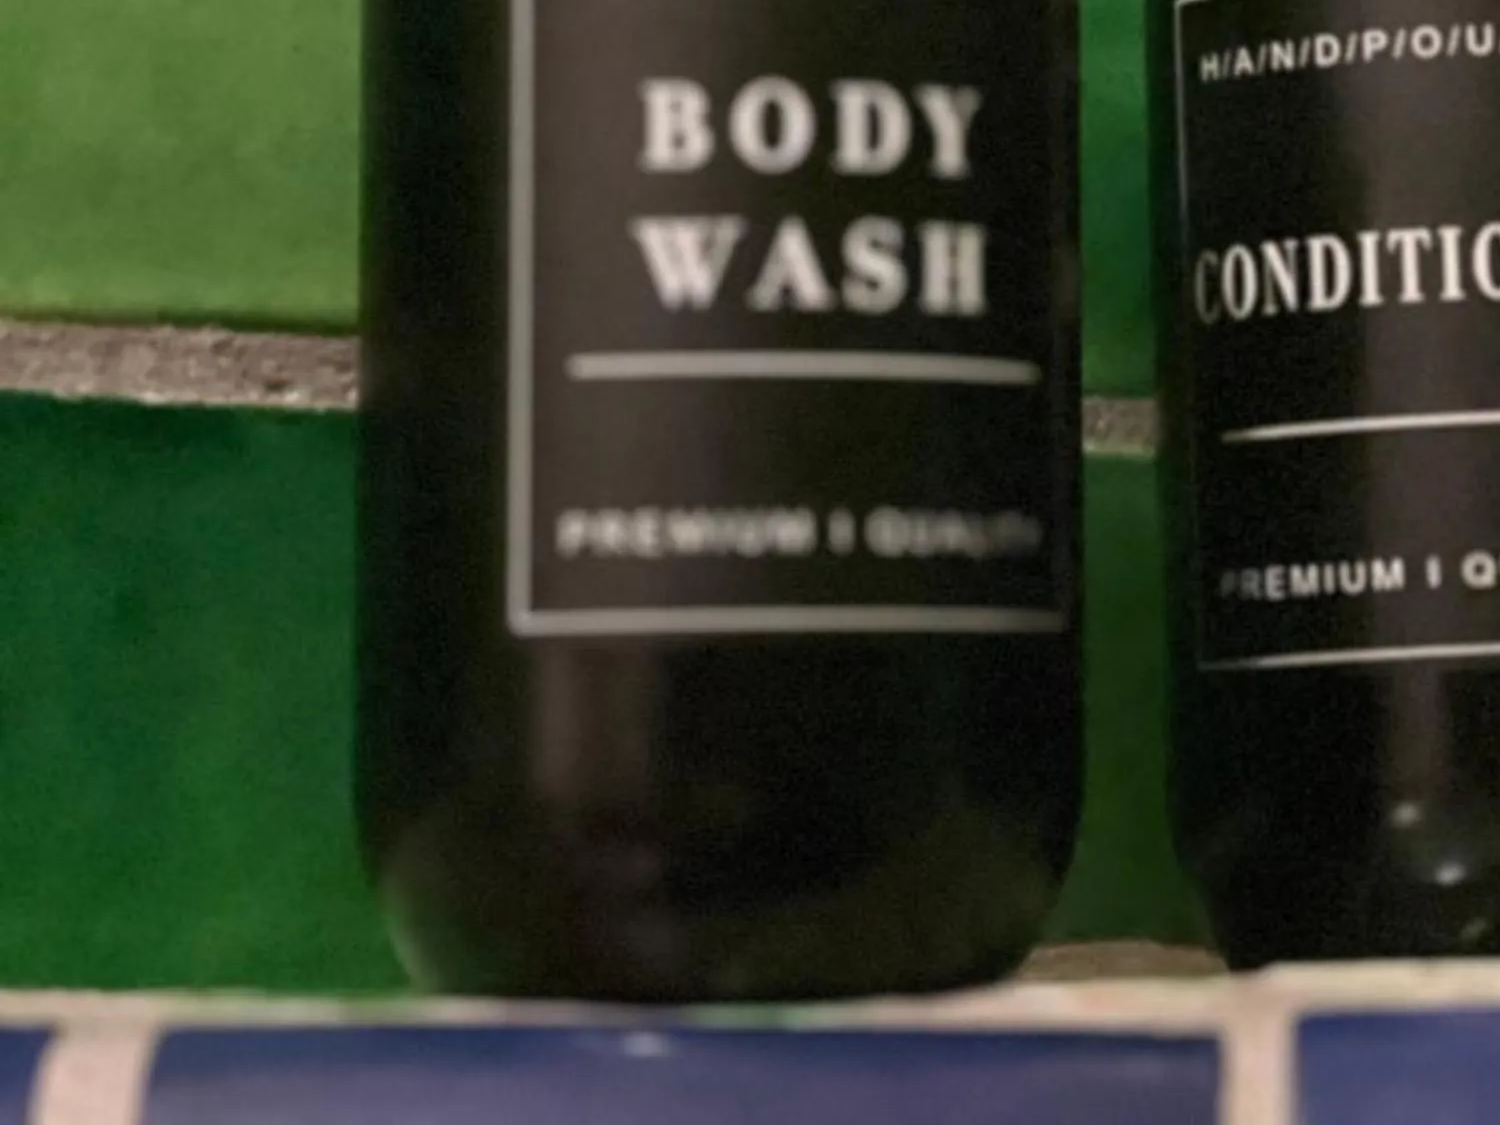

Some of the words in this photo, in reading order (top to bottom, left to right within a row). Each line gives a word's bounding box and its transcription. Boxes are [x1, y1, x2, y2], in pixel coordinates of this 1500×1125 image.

[636, 75, 982, 179] BODY
[627, 213, 988, 316] WASH
[1218, 556, 1405, 601] PREMIUM
